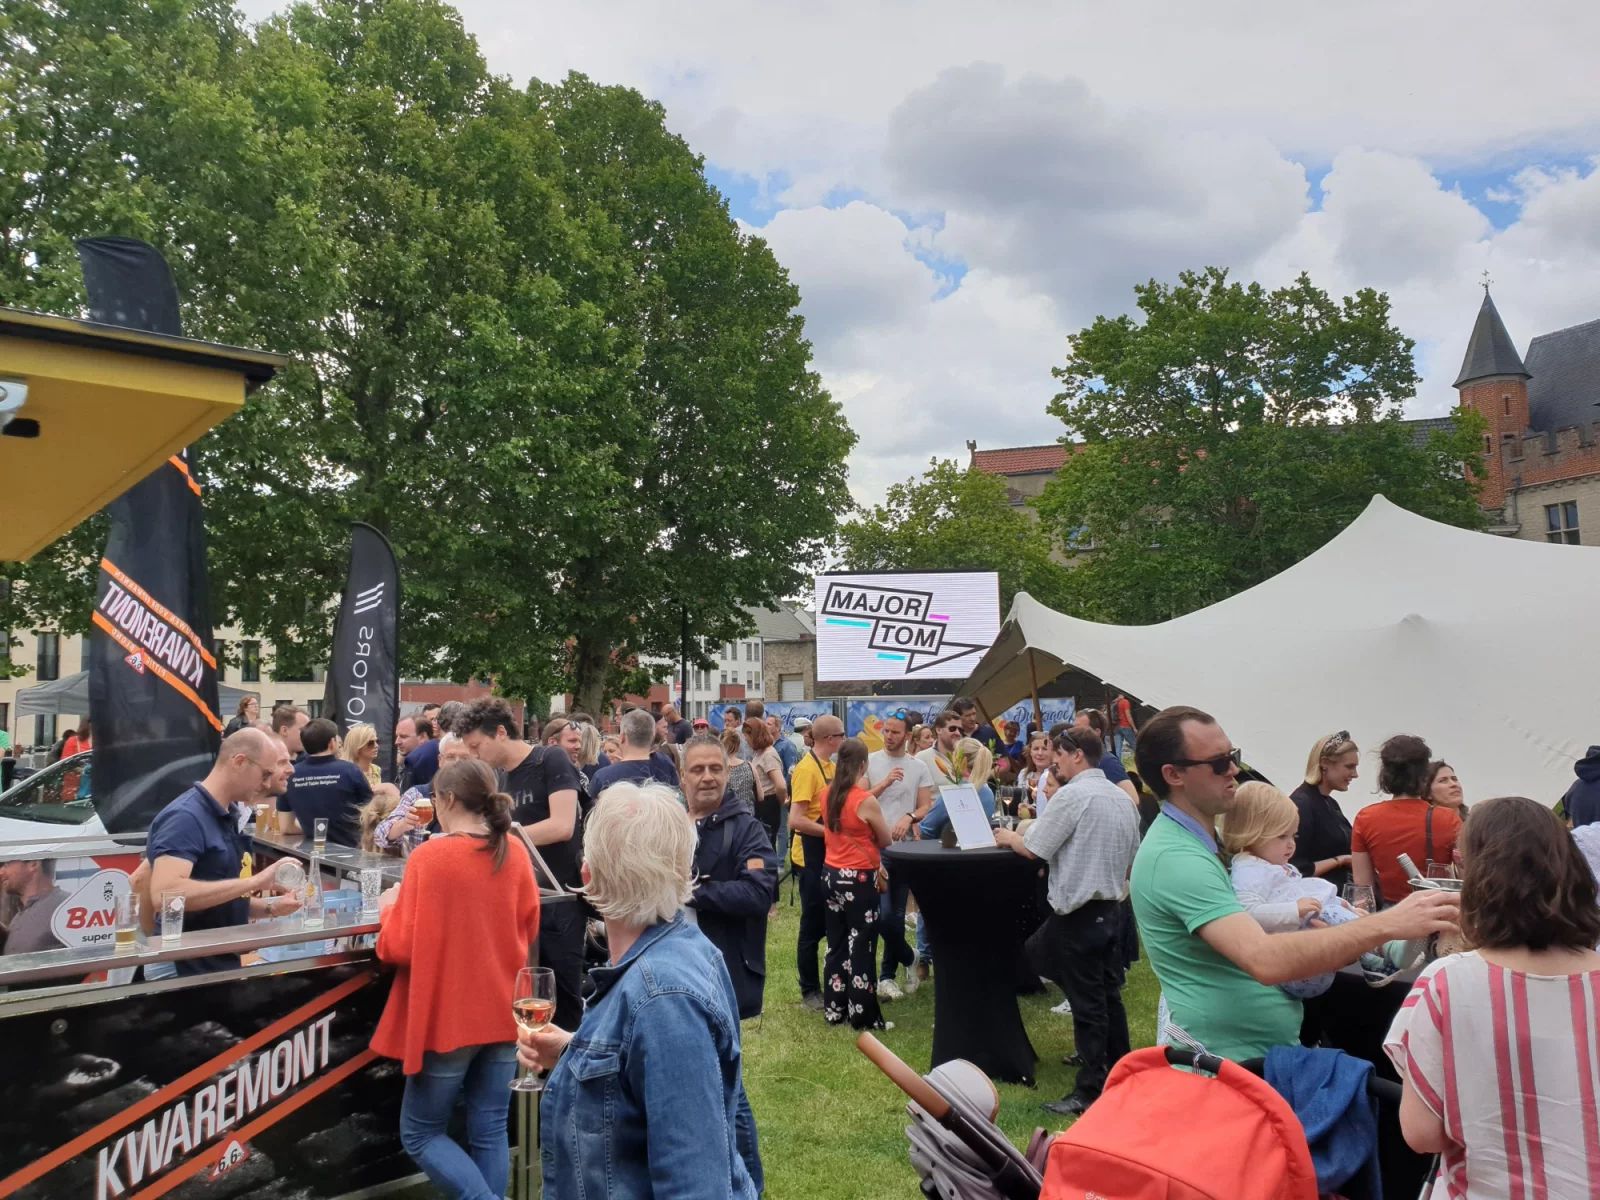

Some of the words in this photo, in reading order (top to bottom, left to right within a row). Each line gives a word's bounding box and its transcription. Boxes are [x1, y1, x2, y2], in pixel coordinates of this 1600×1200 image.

[831, 590, 923, 617] MAJOR
[880, 624, 938, 648] TOM
[66, 907, 117, 929] BAV
[82, 932, 113, 943] super
[97, 1011, 336, 1200] KWAREMONT
